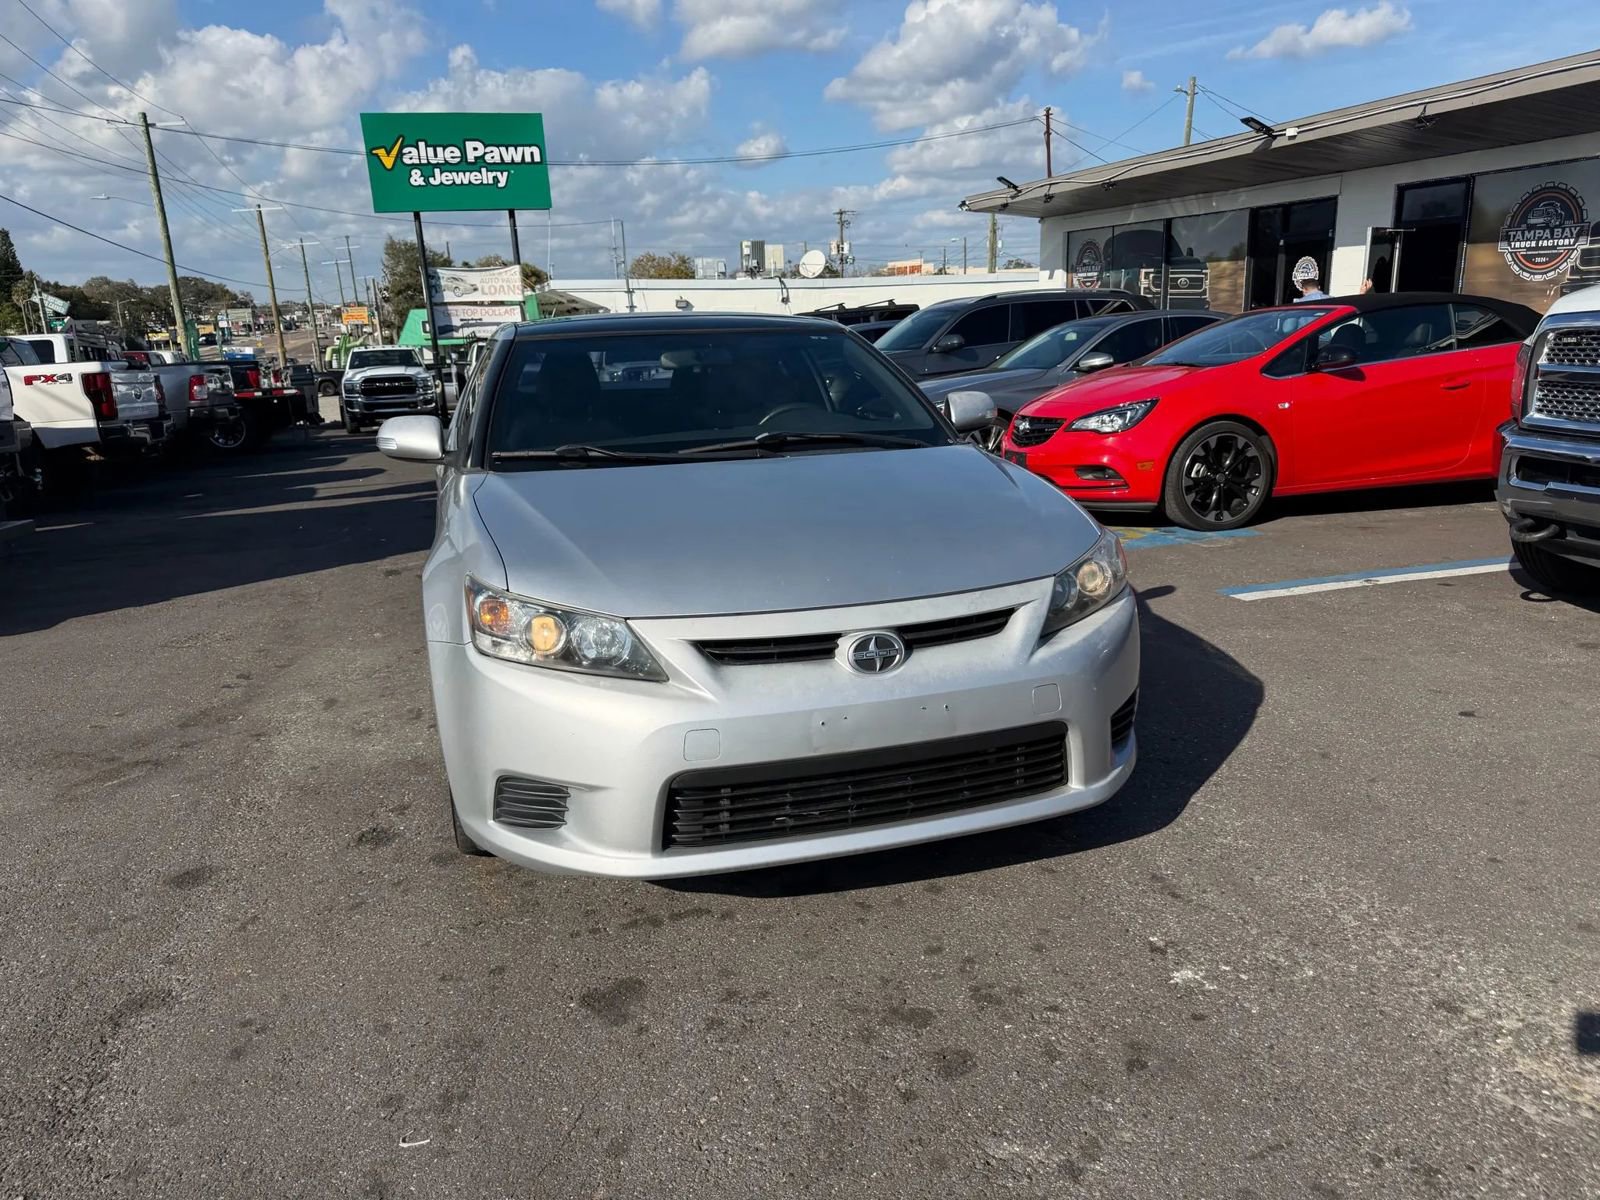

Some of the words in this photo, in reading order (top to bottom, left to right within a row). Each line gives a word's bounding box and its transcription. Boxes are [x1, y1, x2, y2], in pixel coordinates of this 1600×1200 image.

[372, 137, 461, 169] Value
[465, 140, 541, 164] Pawn
[409, 168, 426, 186] &
[429, 167, 509, 187] Jewelry
[1508, 230, 1551, 241] TAMPA
[1553, 227, 1580, 239] BAY
[1511, 240, 1536, 248] TRUCK
[1539, 239, 1575, 247] FACTORY
[480, 284, 522, 296] LOANS
[462, 308, 478, 317] TOP
[480, 307, 516, 317] DOLLAR
[24, 373, 73, 386] FX4
